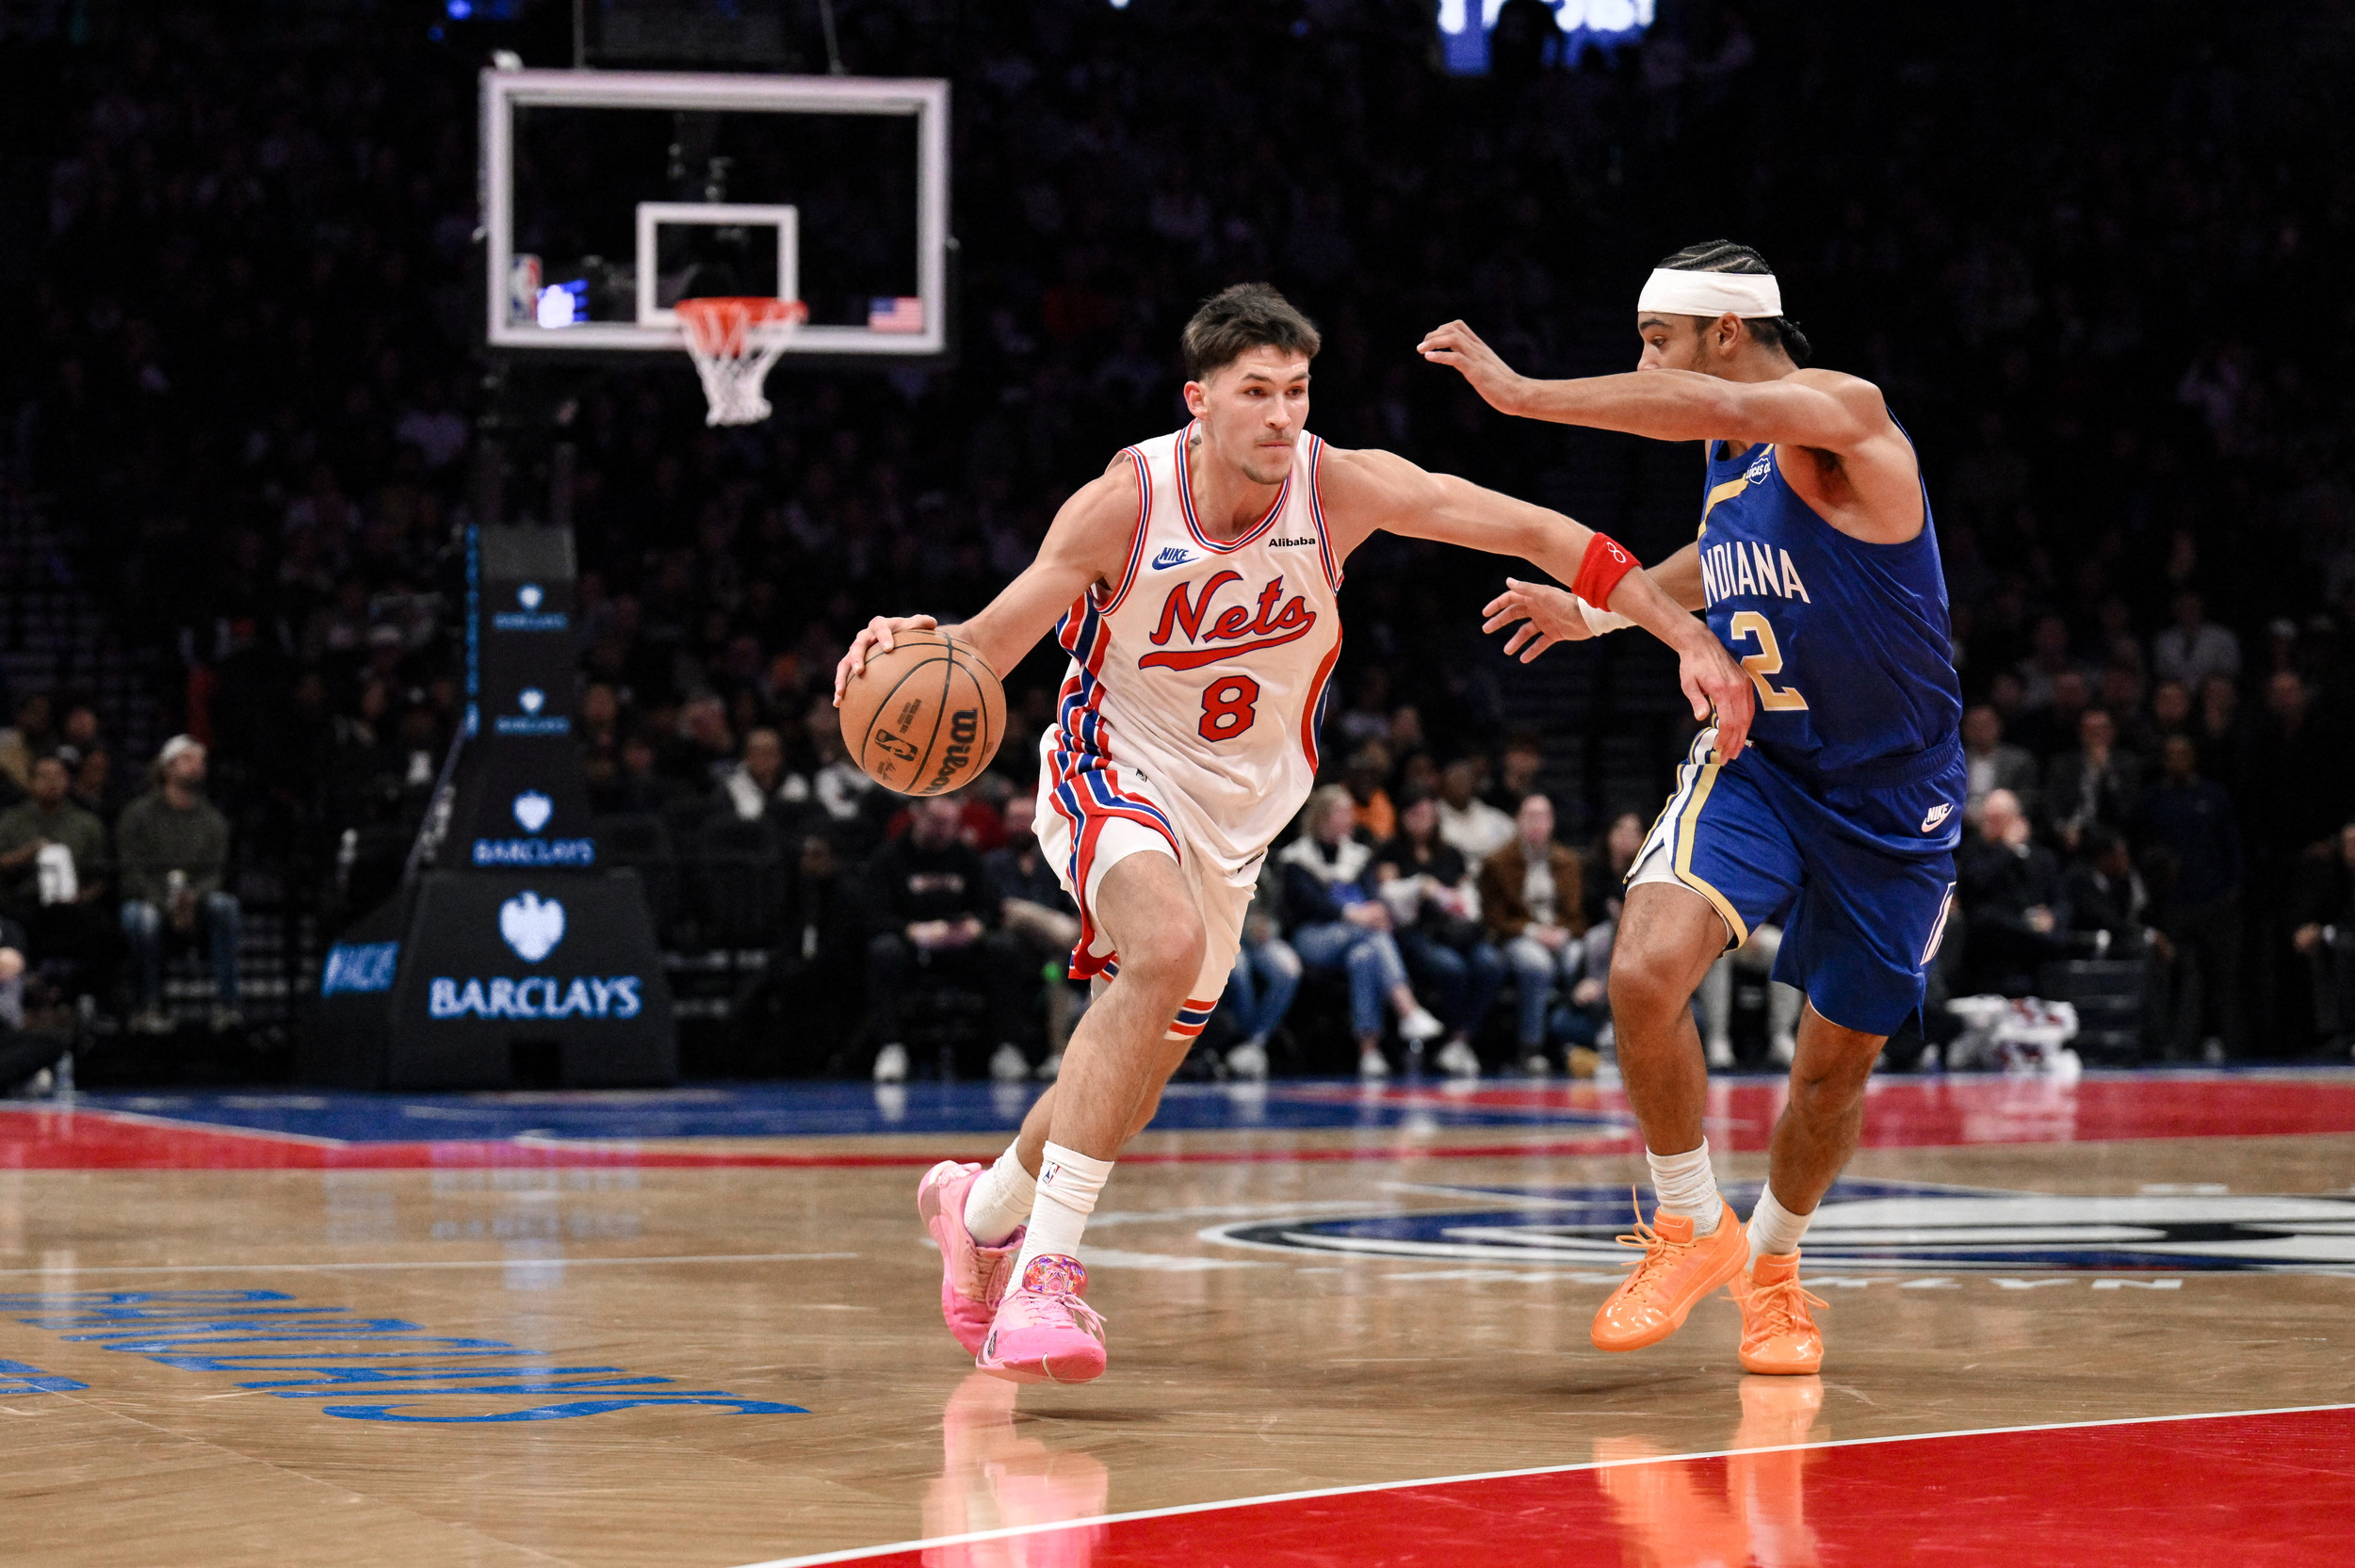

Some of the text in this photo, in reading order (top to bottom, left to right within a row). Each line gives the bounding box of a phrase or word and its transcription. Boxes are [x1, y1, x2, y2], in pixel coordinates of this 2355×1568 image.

[1159, 546, 1189, 562] NIKE
[1268, 537, 1316, 548] Alibaba
[1606, 542, 1626, 563] 8
[1700, 541, 1811, 608] NDIANA
[1149, 570, 1317, 646] Nets
[1730, 610, 1809, 711] 2
[1198, 675, 1260, 742] 8
[918, 707, 979, 794] Wilson
[1926, 802, 1950, 823] NIKE
[473, 838, 594, 866] BARCLAYS
[429, 976, 642, 1019] BARCLAYS
[0, 1290, 811, 1422] BARCLAYS
